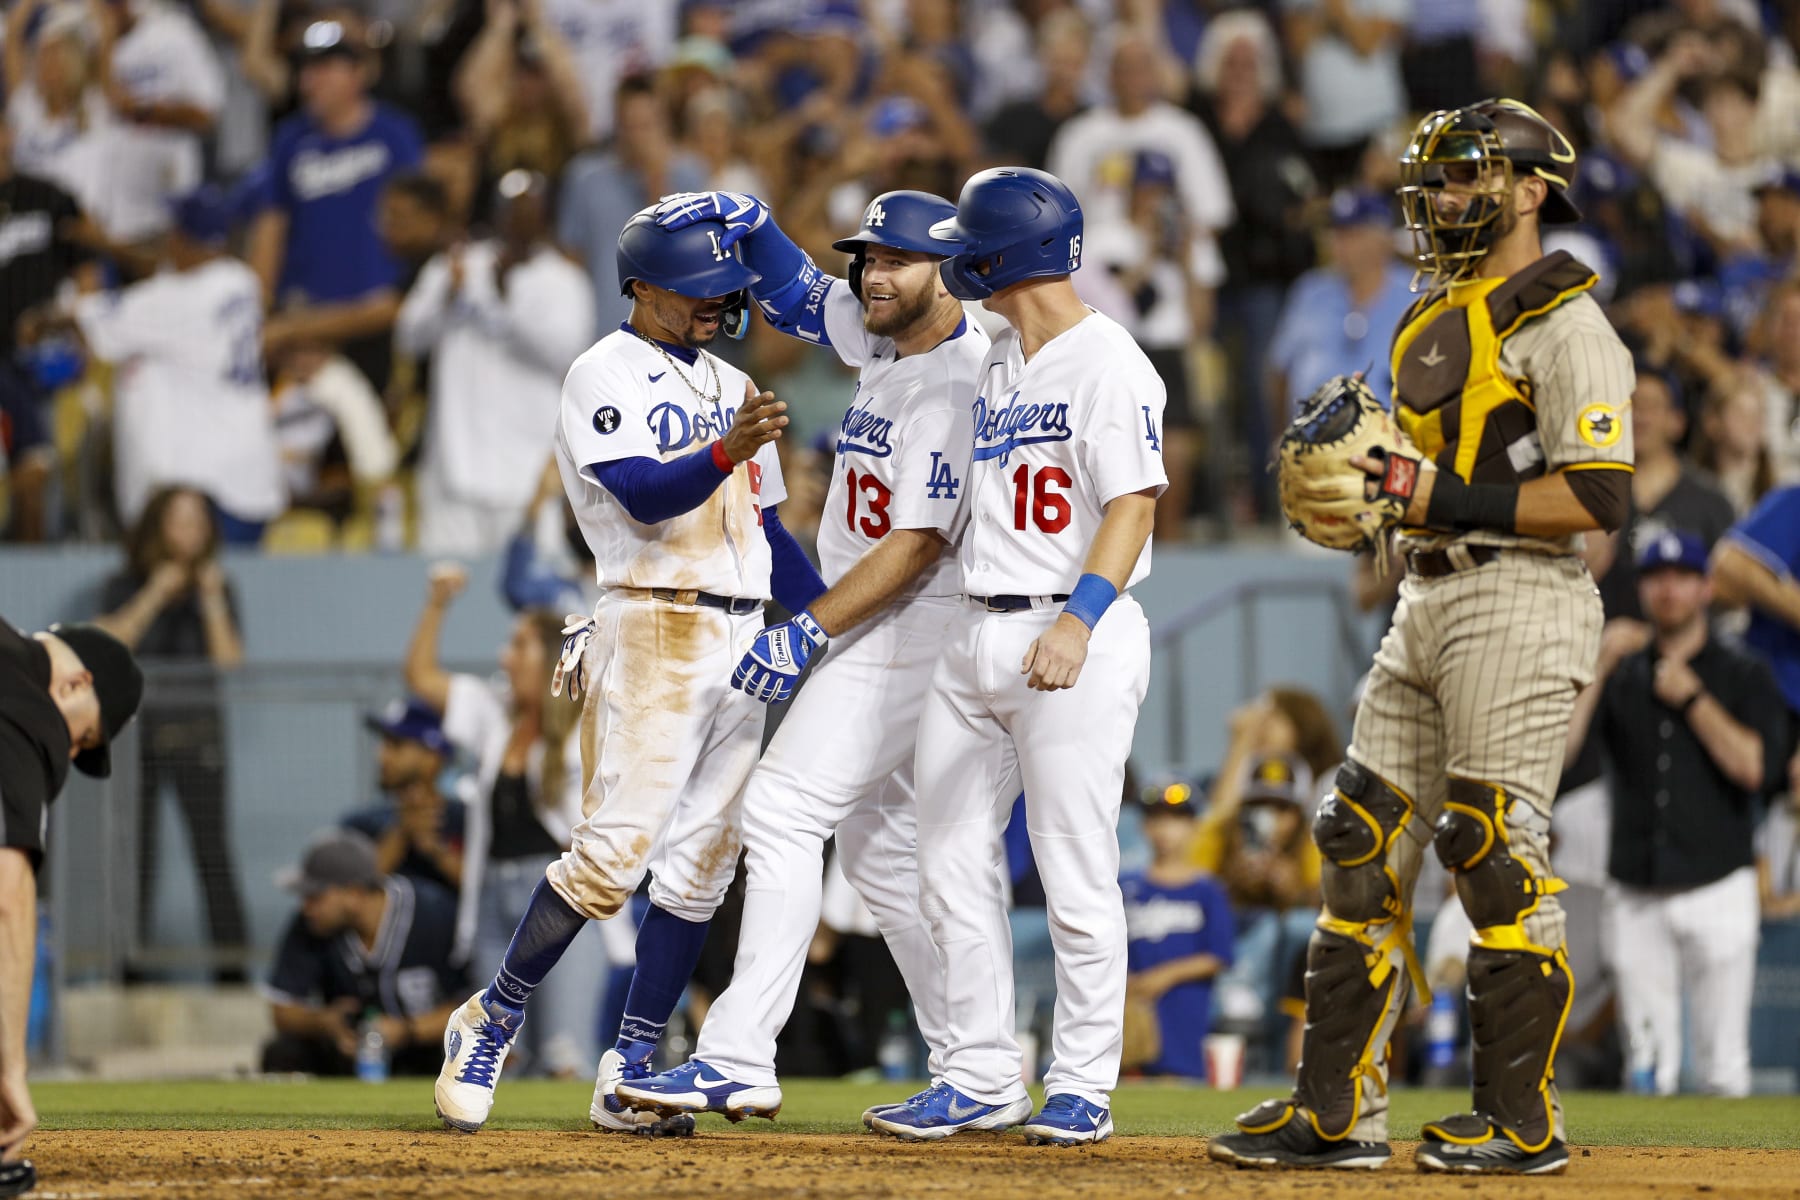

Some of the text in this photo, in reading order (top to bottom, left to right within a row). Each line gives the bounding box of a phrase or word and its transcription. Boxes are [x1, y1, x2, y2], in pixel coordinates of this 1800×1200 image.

[866, 199, 886, 227] LA
[1069, 234, 1081, 259] 16
[597, 408, 614, 421] VIN
[926, 451, 960, 499] LA
[847, 467, 894, 539] 13
[1012, 463, 1073, 534] 16
